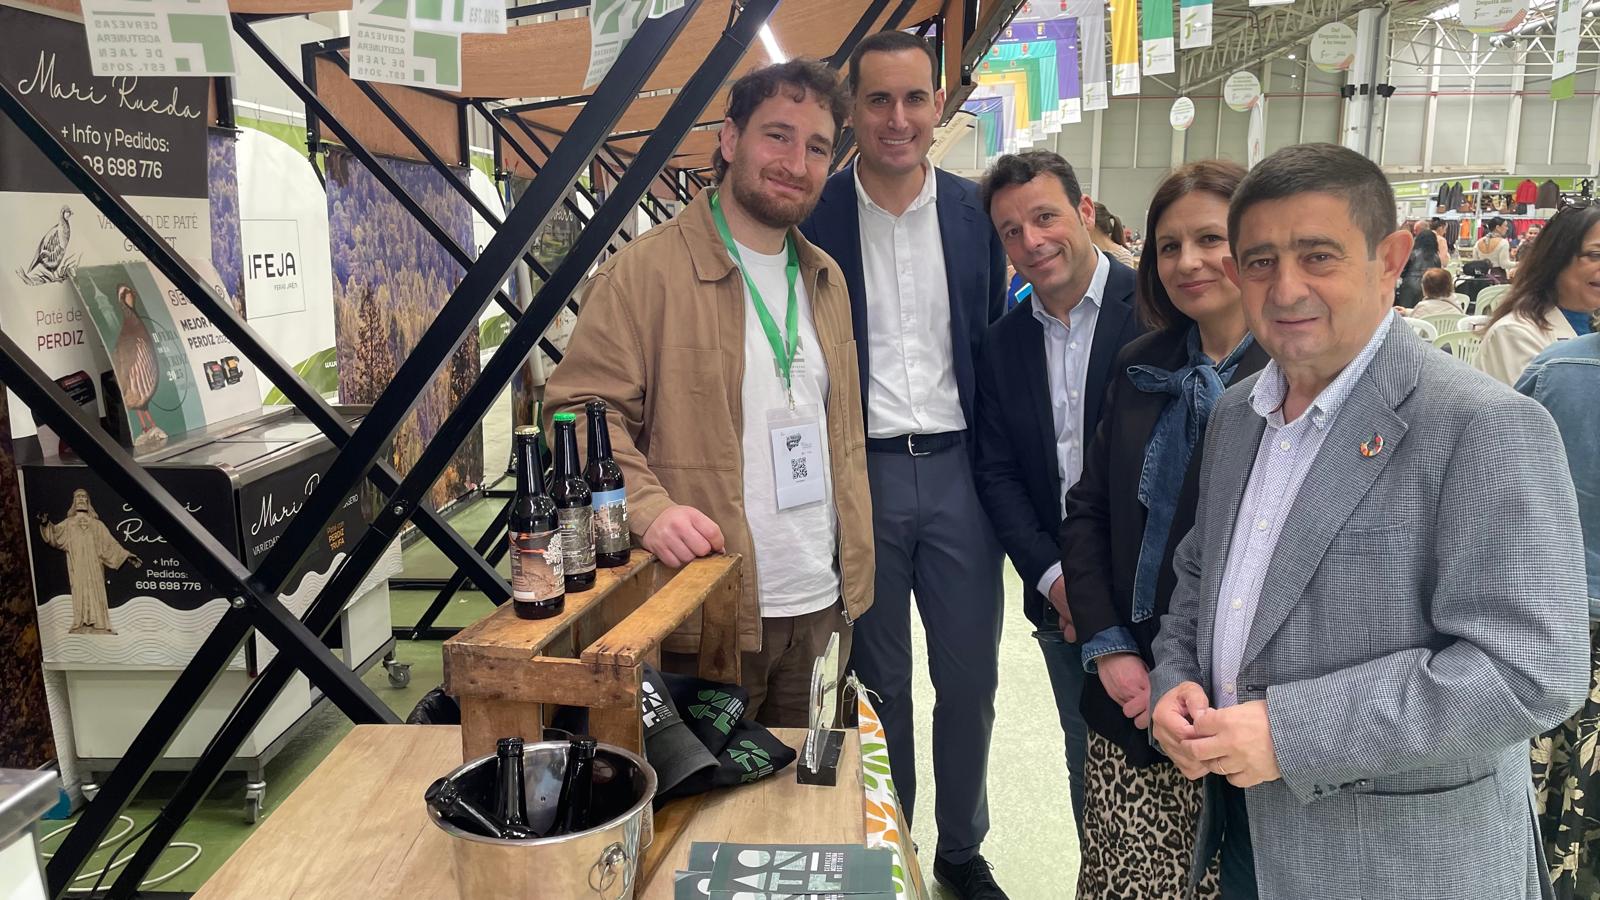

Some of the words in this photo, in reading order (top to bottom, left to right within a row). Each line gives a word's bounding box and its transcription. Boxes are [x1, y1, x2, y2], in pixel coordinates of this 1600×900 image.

[18, 50, 107, 104] Mari
[112, 75, 200, 119] Rueda
[72, 123, 101, 145] Info
[104, 132, 112, 151] y
[115, 128, 170, 153] Pedidos:
[108, 156, 137, 177] 698
[139, 160, 163, 179] 776
[156, 215, 170, 229] DE
[173, 212, 199, 229] PATÉ
[248, 252, 296, 279] IFEJA
[36, 309, 63, 326] Paté
[66, 306, 82, 322] de
[180, 317, 209, 331] MEJOR
[37, 330, 85, 351] PERDIZ
[187, 334, 216, 349] PERDIZ
[251, 493, 303, 536] Mari
[160, 557, 180, 567] Info
[146, 569, 189, 579] Pedidos:
[135, 581, 157, 590] 608
[159, 581, 180, 591] 698
[182, 582, 202, 591] 776
